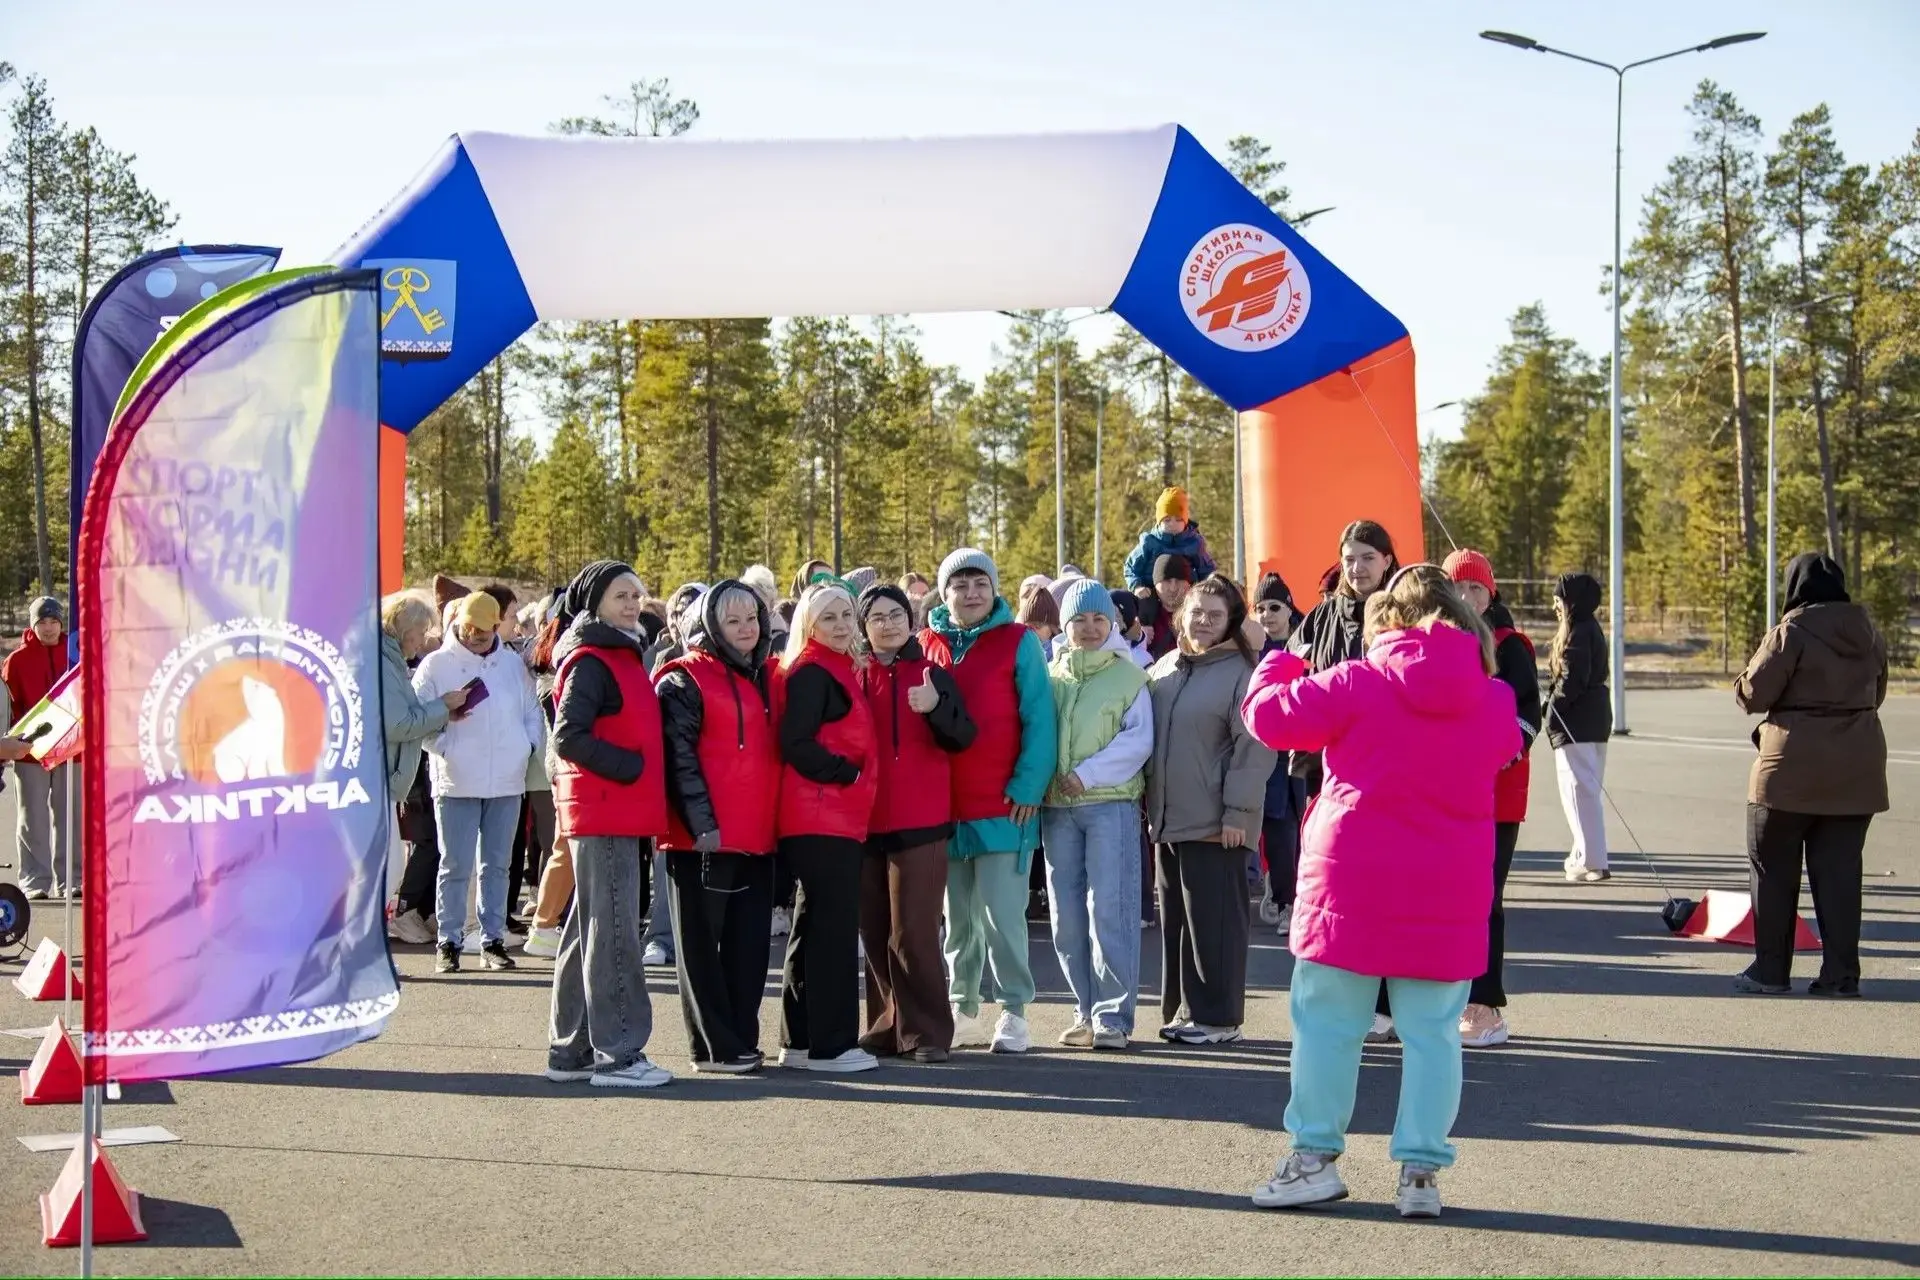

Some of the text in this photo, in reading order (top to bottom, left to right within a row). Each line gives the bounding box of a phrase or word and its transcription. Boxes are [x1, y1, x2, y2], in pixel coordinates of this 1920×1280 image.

[1186, 230, 1263, 297] СПОРТИВНАЯ
[1201, 241, 1245, 283] ШКОЛА
[1244, 292, 1302, 342] АРКТИКА
